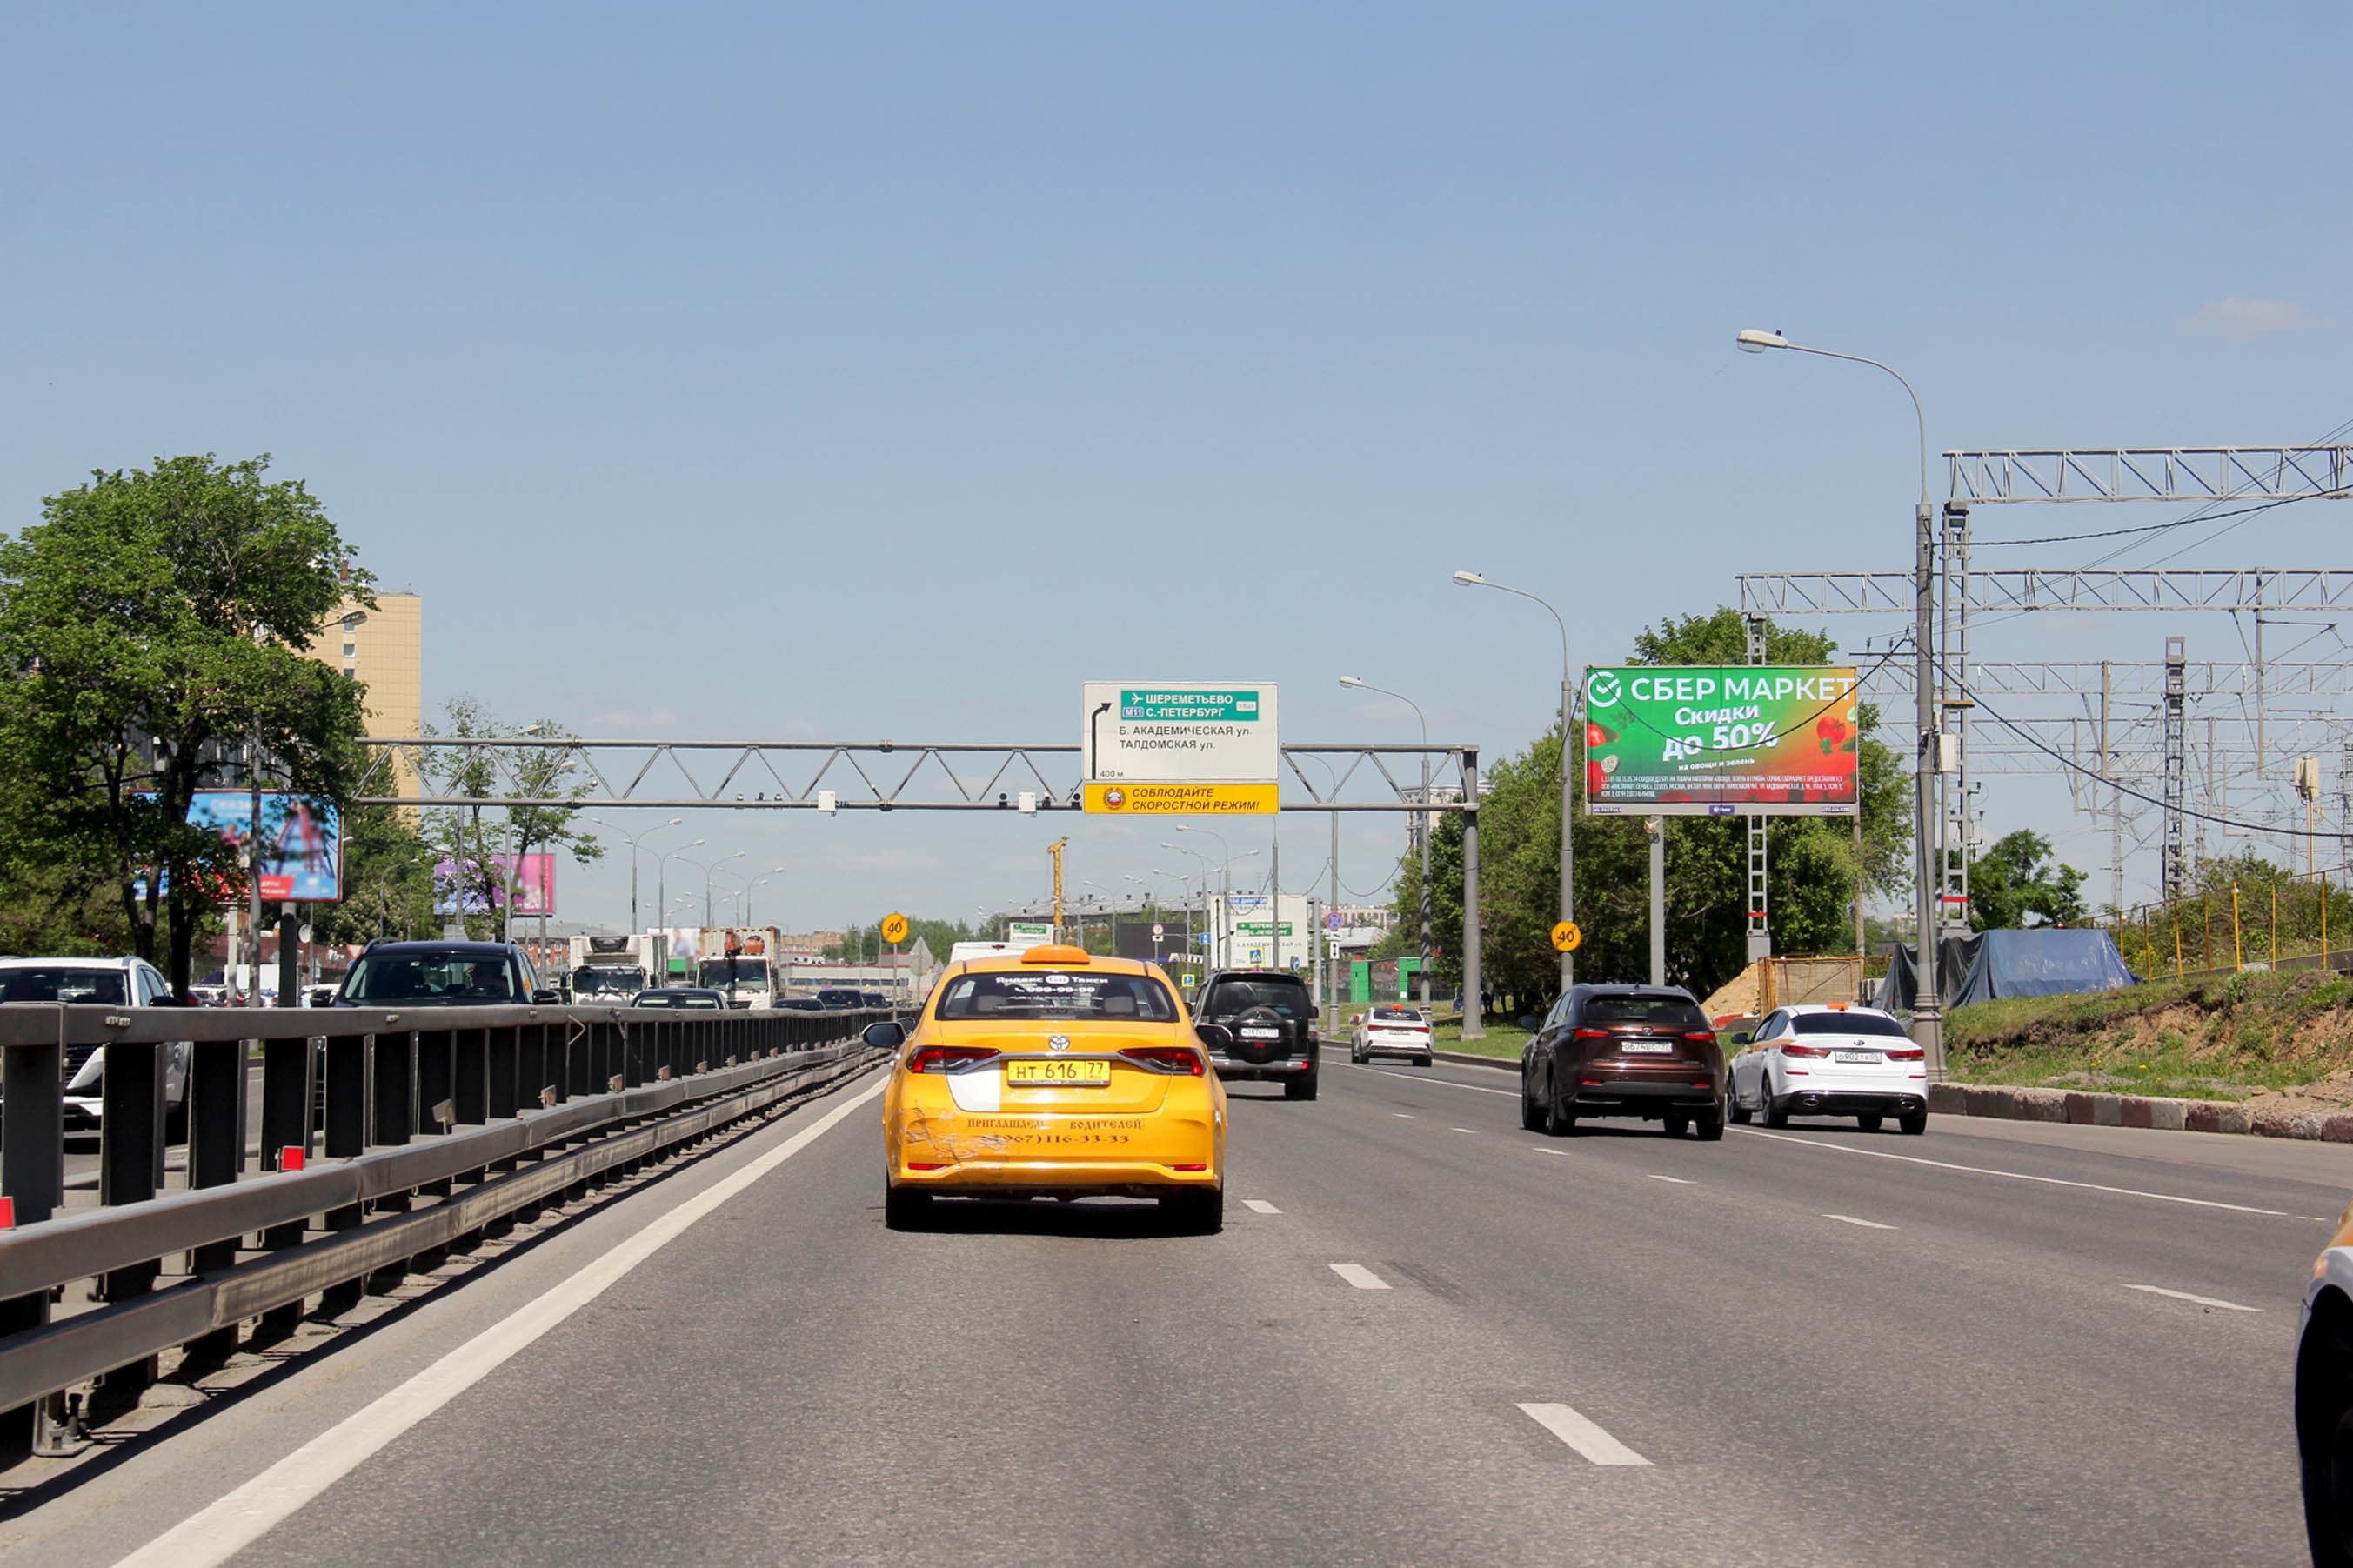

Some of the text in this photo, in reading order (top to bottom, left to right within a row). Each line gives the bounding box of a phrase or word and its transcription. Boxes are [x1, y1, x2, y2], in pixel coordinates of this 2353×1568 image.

[1630, 677, 1855, 701] СБЕР МАРКЕТ
[1146, 695, 1233, 704] ШЕРЕМЕТЬЕВО
[1146, 707, 1225, 717] С.-ПЕТЕРБУРГ
[1675, 704, 1760, 727] Скидки
[1119, 726, 1253, 737] Б. АКАДЕМИЧЕСКАЯ ул.
[1120, 740, 1216, 751] ТАЛДОМСКАЯ ул.
[1662, 721, 1780, 762] до 50%
[1100, 770, 1115, 778] 400
[1132, 787, 1215, 798] СОБЛЮДАЙТЕ
[1132, 799, 1260, 811] СКОРОСТНОЙ РЕЖИМ!
[887, 922, 903, 933] 40
[1557, 931, 1574, 943] 40
[1016, 1062, 1104, 1079] НТ 616 77
